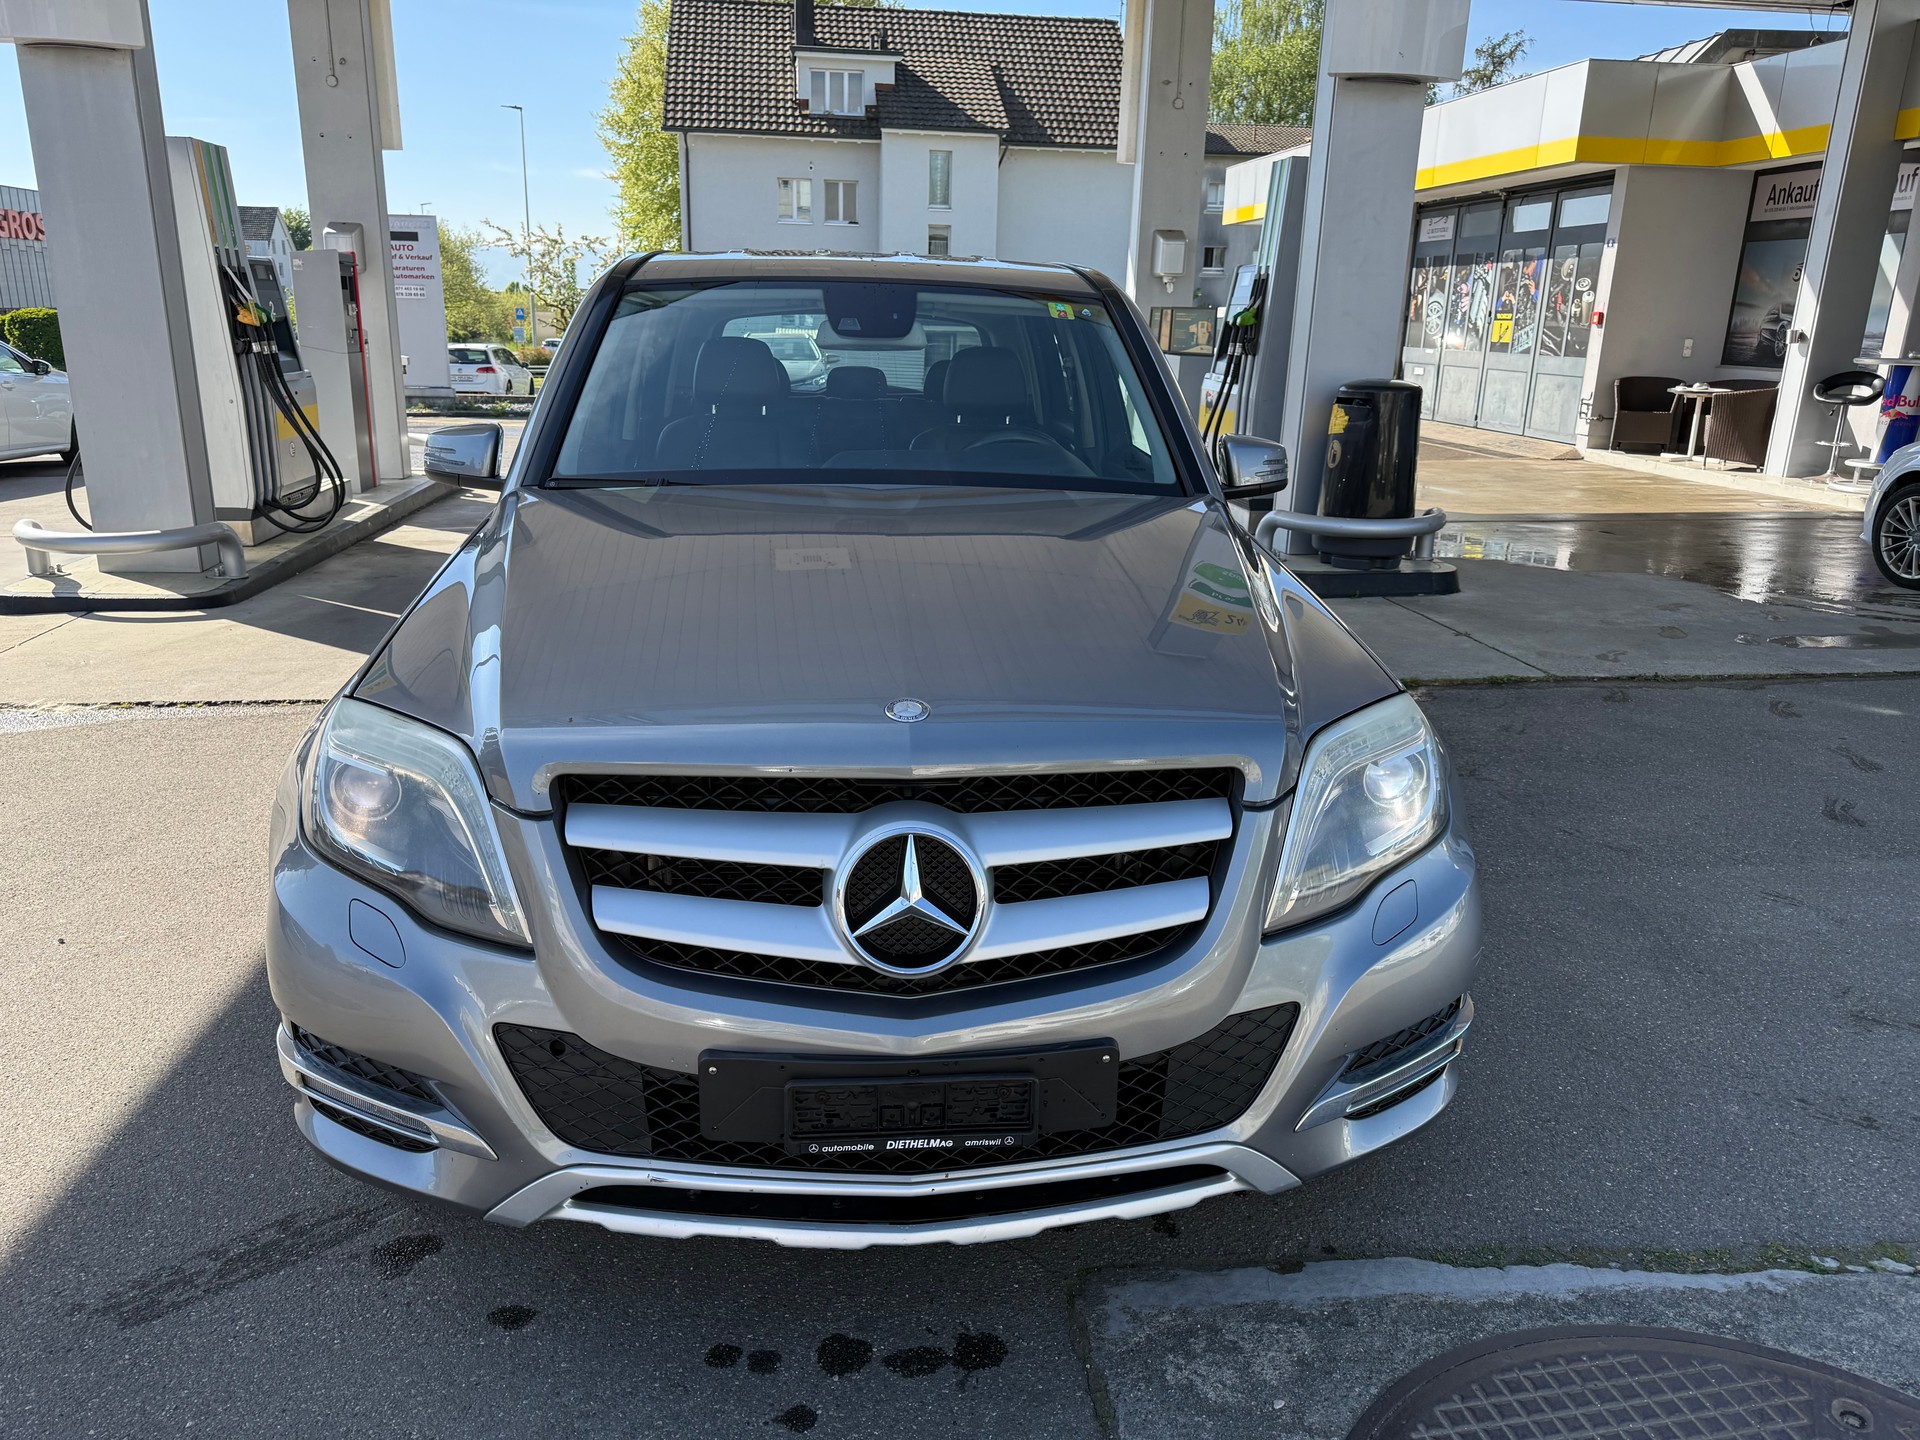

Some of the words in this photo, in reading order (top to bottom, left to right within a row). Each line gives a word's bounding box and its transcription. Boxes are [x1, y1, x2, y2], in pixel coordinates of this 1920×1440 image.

[1766, 178, 1820, 206] Ankauf
[822, 1143, 875, 1153] automobile
[965, 1138, 1001, 1147] amriswil
